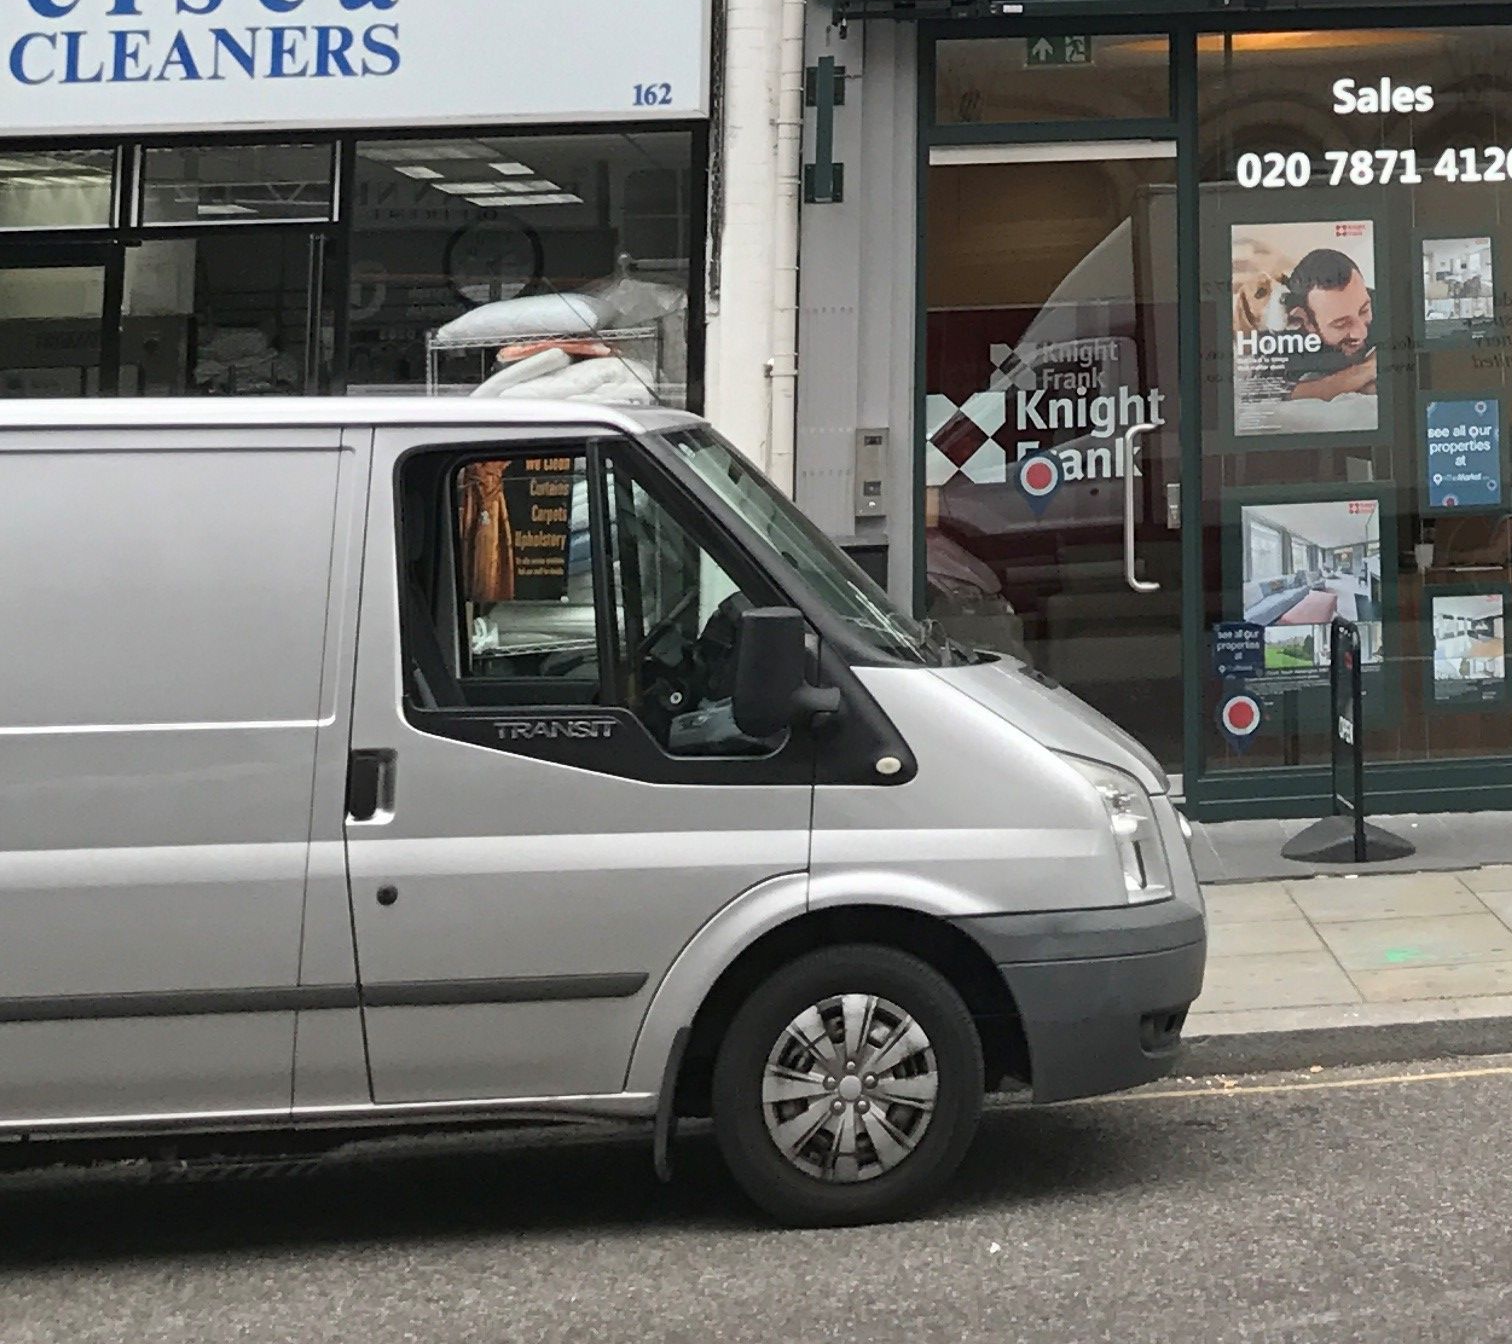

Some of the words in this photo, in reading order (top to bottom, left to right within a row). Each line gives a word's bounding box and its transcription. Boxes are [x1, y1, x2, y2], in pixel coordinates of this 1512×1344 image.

[8, 23, 402, 86] CLEANERS
[632, 83, 672, 107] 162
[1332, 76, 1434, 114] Sales
[1236, 151, 1311, 188] 020
[1324, 149, 1422, 186] 7871
[1042, 339, 1119, 367] Knight
[1237, 330, 1321, 355] Home
[1043, 368, 1106, 390] Frank
[1017, 386, 1165, 437] Knight
[1428, 427, 1449, 438] see
[1453, 426, 1466, 436] all
[1017, 438, 1143, 481] ank
[1430, 441, 1490, 455] properties
[1455, 455, 1466, 466] at
[532, 504, 567, 524] Carpets
[515, 530, 566, 550] Upholstery
[494, 721, 616, 739] TRANSIT
